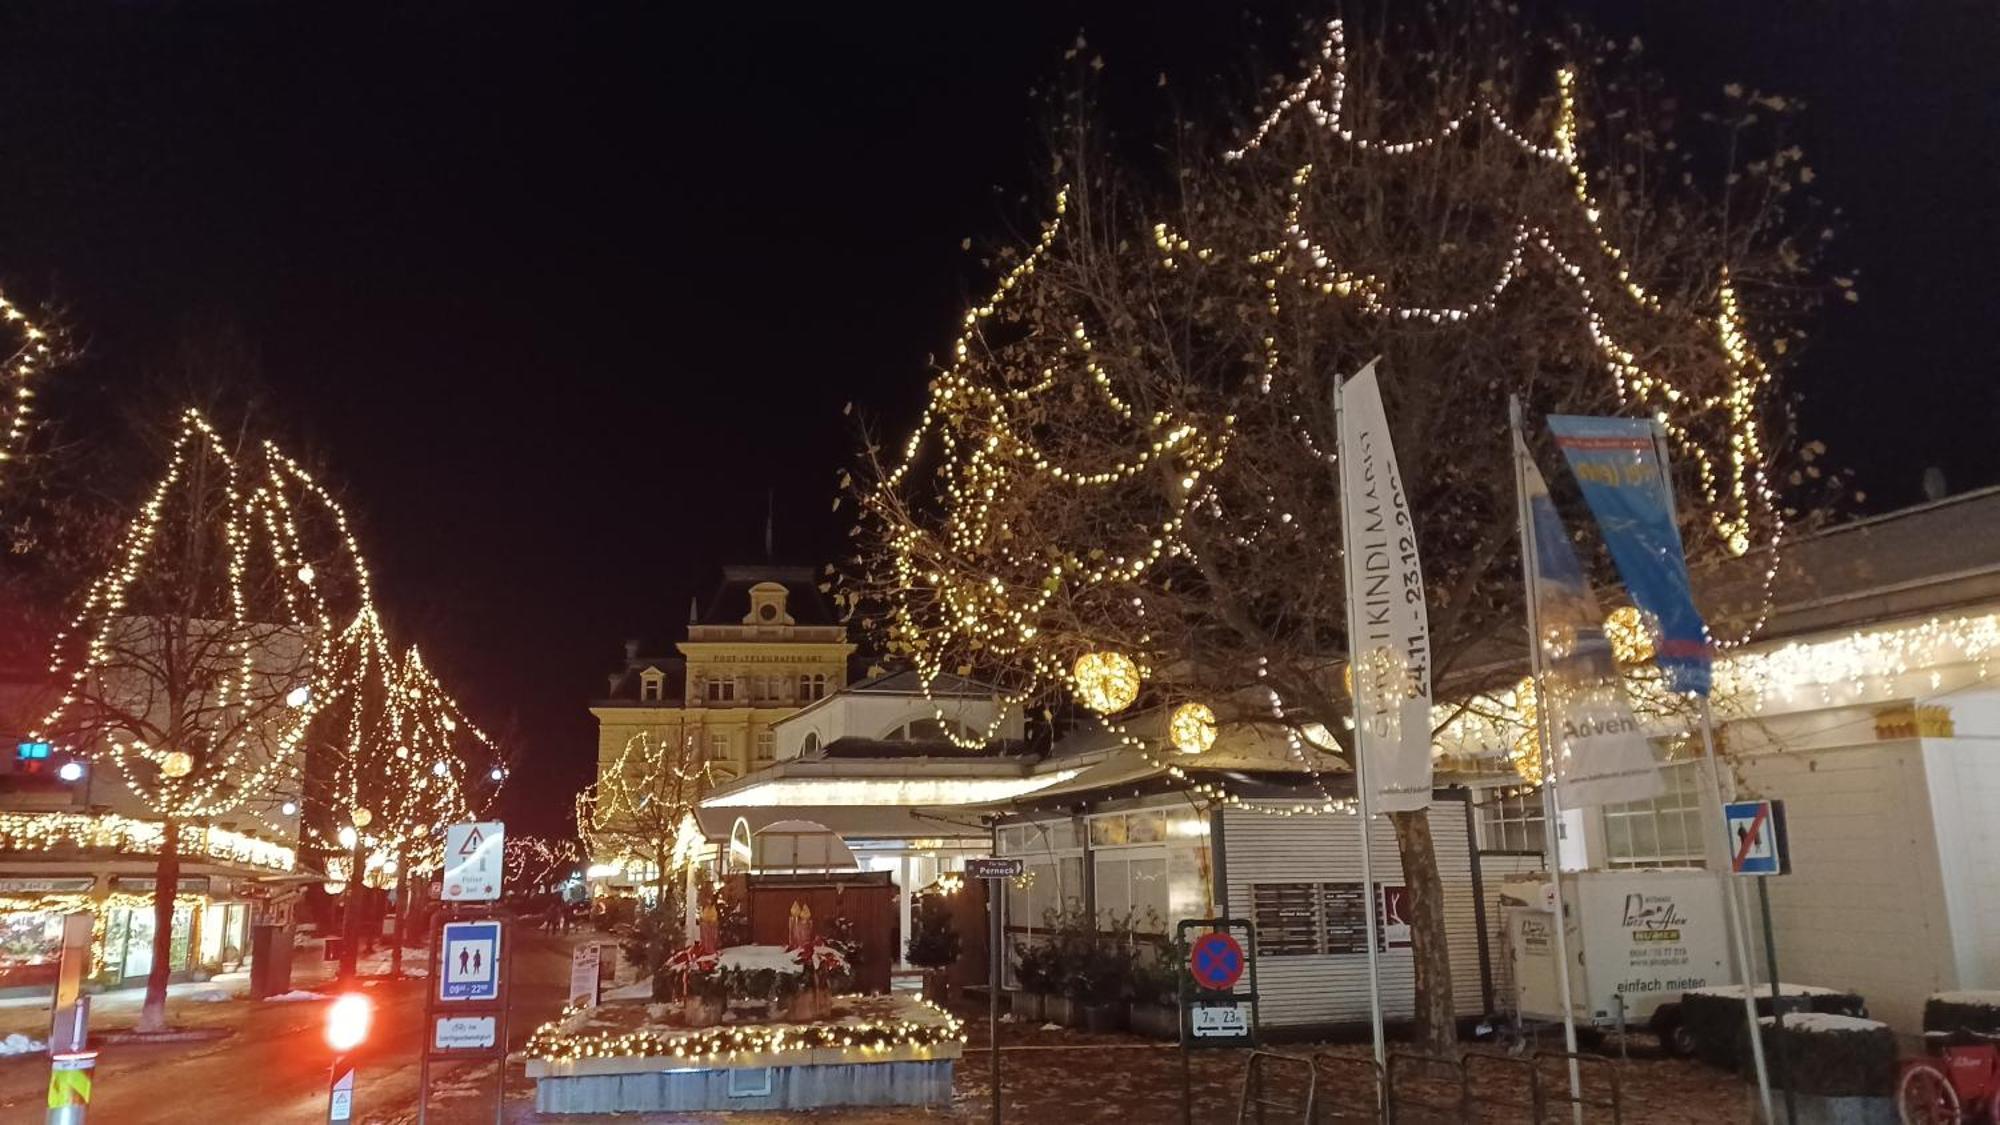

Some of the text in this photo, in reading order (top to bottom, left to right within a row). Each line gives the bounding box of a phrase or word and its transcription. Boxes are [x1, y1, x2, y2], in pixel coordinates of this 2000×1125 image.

[1407, 625, 1427, 700] 24.11.
[1563, 718, 1634, 739] Adven
[979, 867, 1015, 875] Perneck
[1617, 977, 1706, 992] einfach mieten
